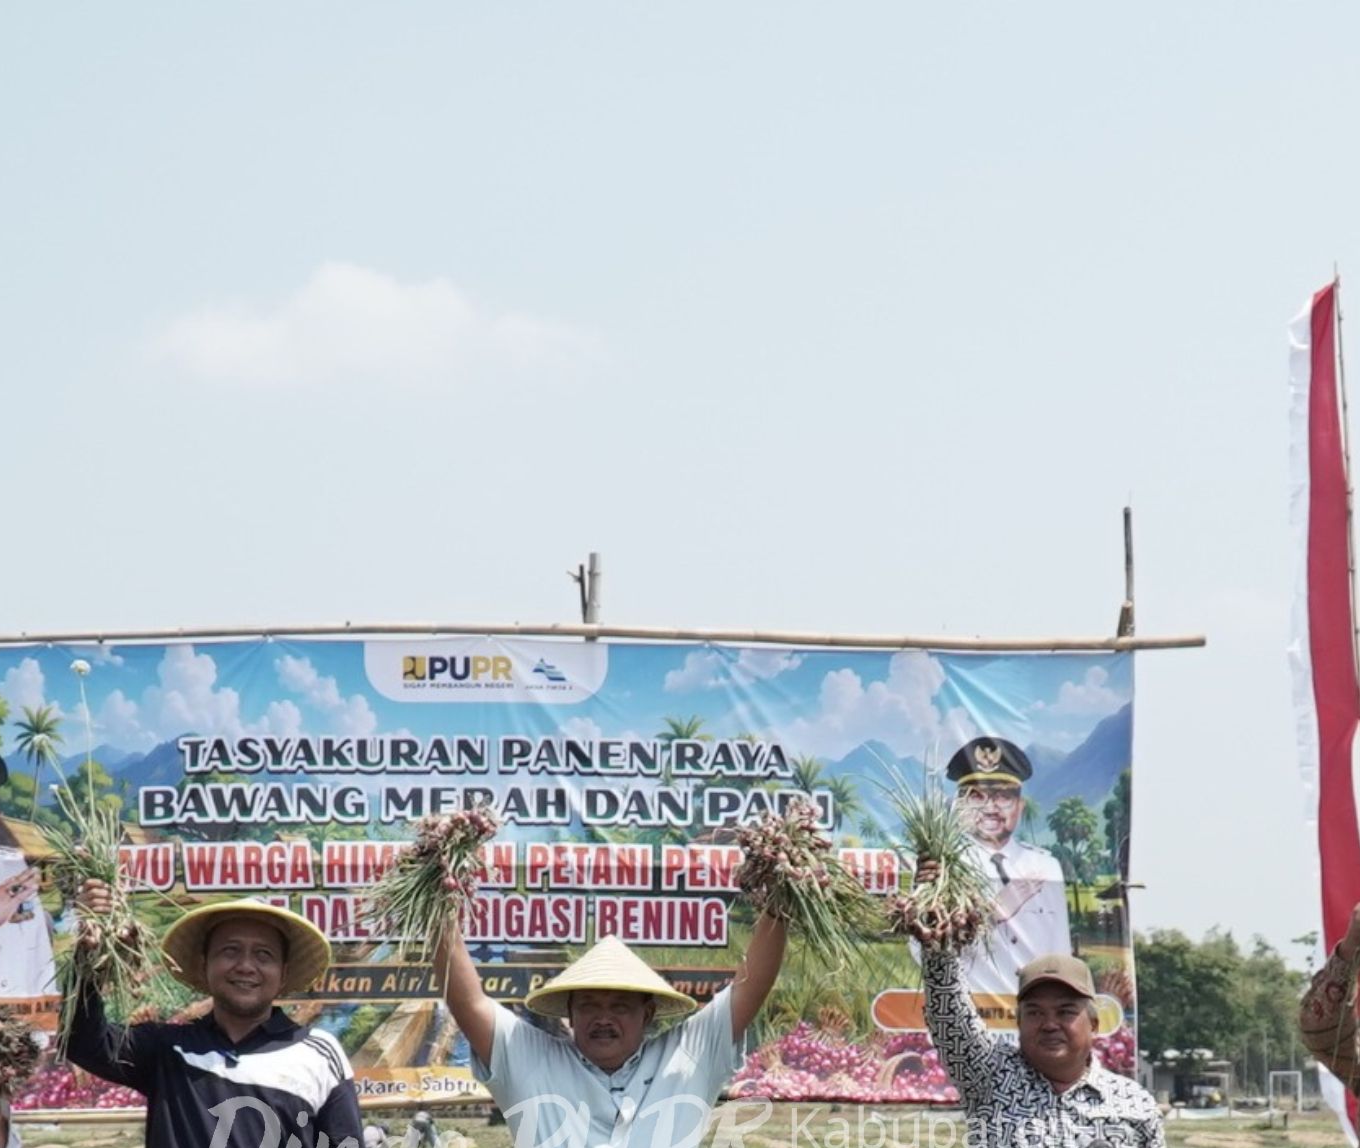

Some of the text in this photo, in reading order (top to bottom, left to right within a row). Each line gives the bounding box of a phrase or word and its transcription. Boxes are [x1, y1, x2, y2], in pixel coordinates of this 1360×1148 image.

[428, 655, 513, 681] PUPR
[181, 736, 791, 774] TASYAKURAN PANEN RAYA
[141, 786, 368, 822] BAWANG
[585, 788, 690, 822] DAN
[185, 843, 311, 887] WARGA
[528, 846, 650, 887] PETANI
[842, 851, 896, 891] AIR
[598, 899, 725, 941] BENING
